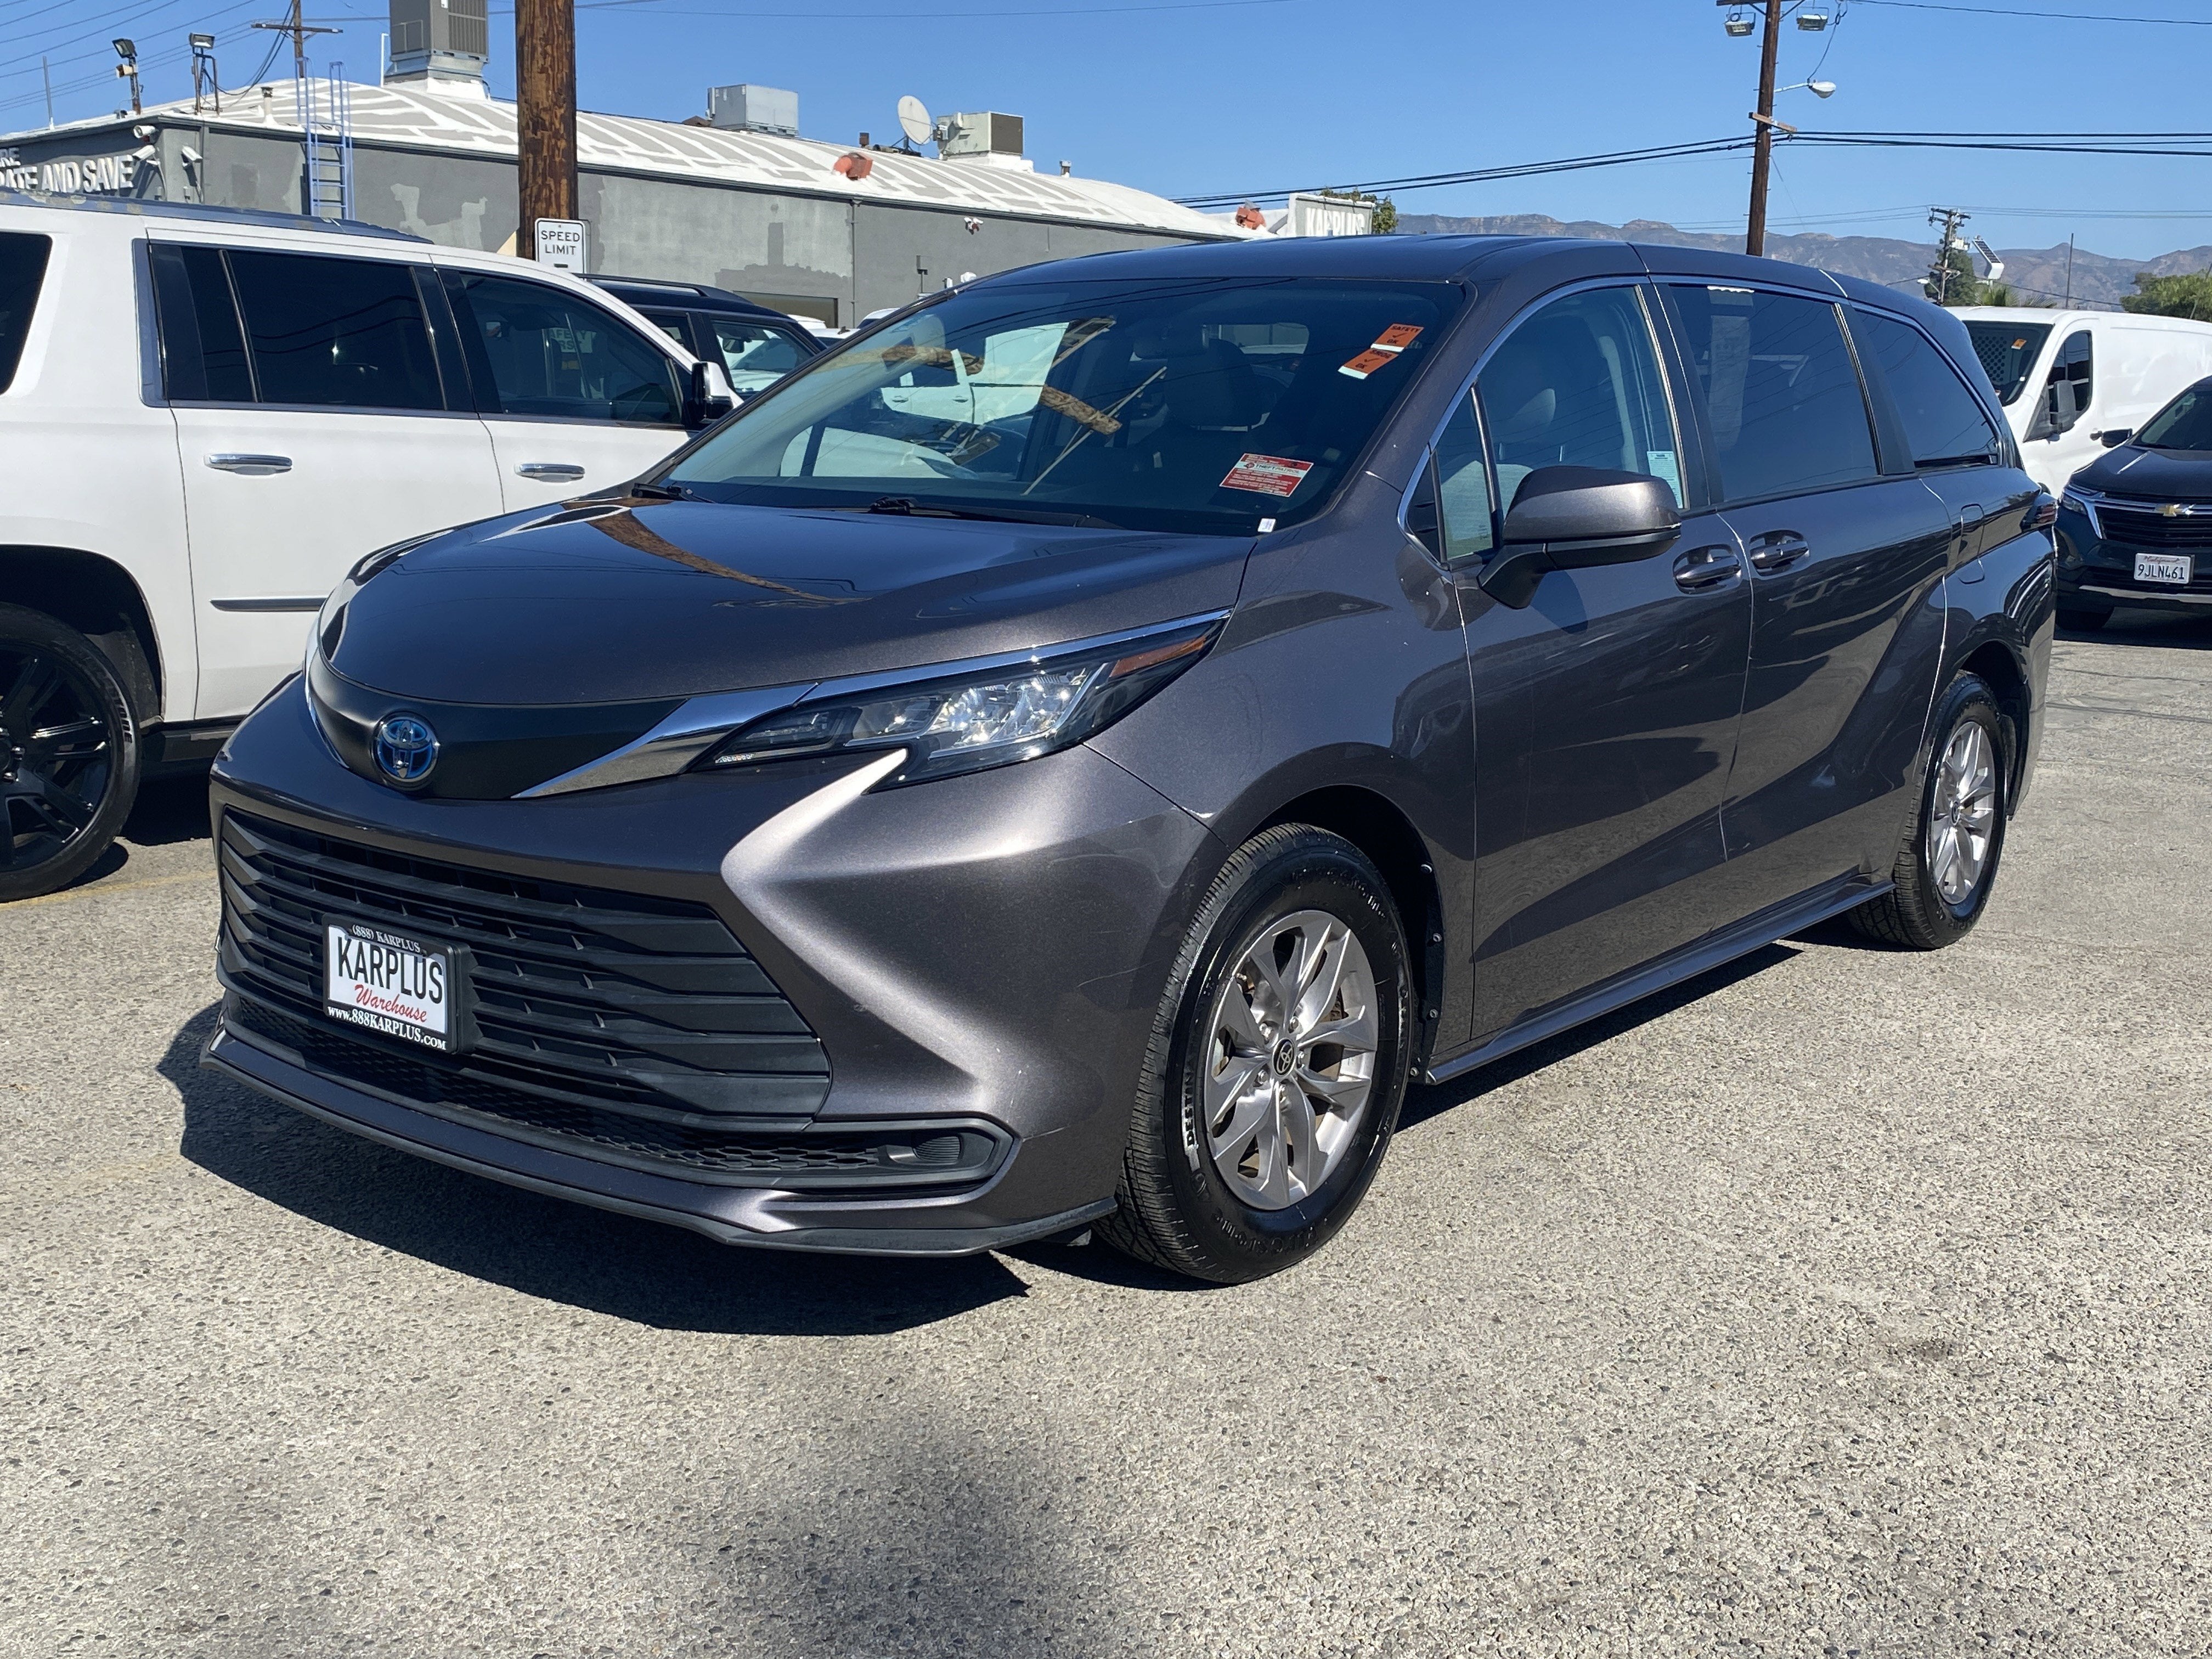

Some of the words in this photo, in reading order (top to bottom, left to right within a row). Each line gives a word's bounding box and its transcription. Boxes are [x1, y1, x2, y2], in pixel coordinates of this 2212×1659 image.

[42, 162, 81, 193] AND
[83, 155, 133, 193] SAVE
[540, 230, 580, 242] SPEED
[545, 244, 576, 255] LIMIT
[2138, 564, 2185, 580] 9JLN461
[352, 924, 374, 940] (888)
[375, 931, 421, 953] KARPLUS
[337, 936, 443, 1004] KARPLUS
[354, 984, 427, 1023] Warehouse
